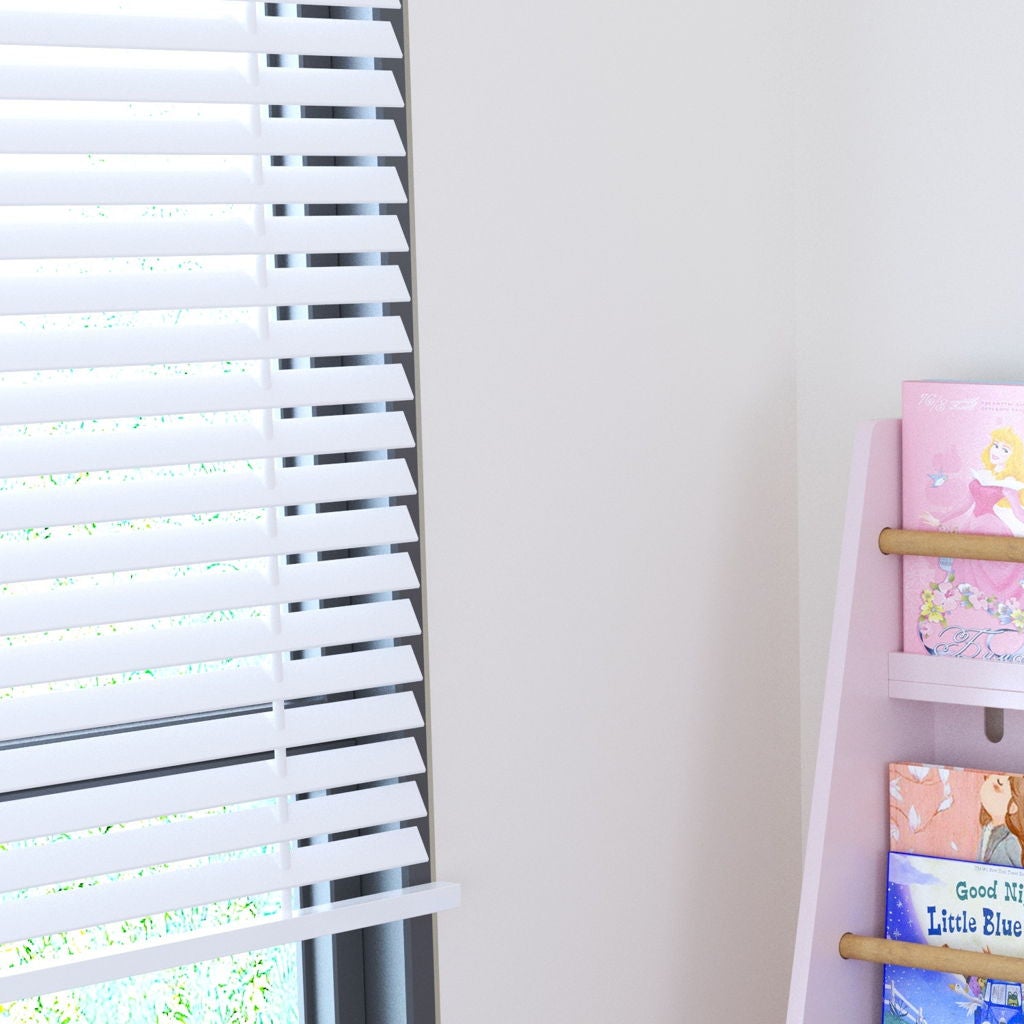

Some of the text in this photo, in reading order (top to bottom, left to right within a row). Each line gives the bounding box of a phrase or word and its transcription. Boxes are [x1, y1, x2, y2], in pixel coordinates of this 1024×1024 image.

[956, 879, 997, 902] Good
[927, 906, 977, 936] Little
[982, 910, 1022, 938] Blue
